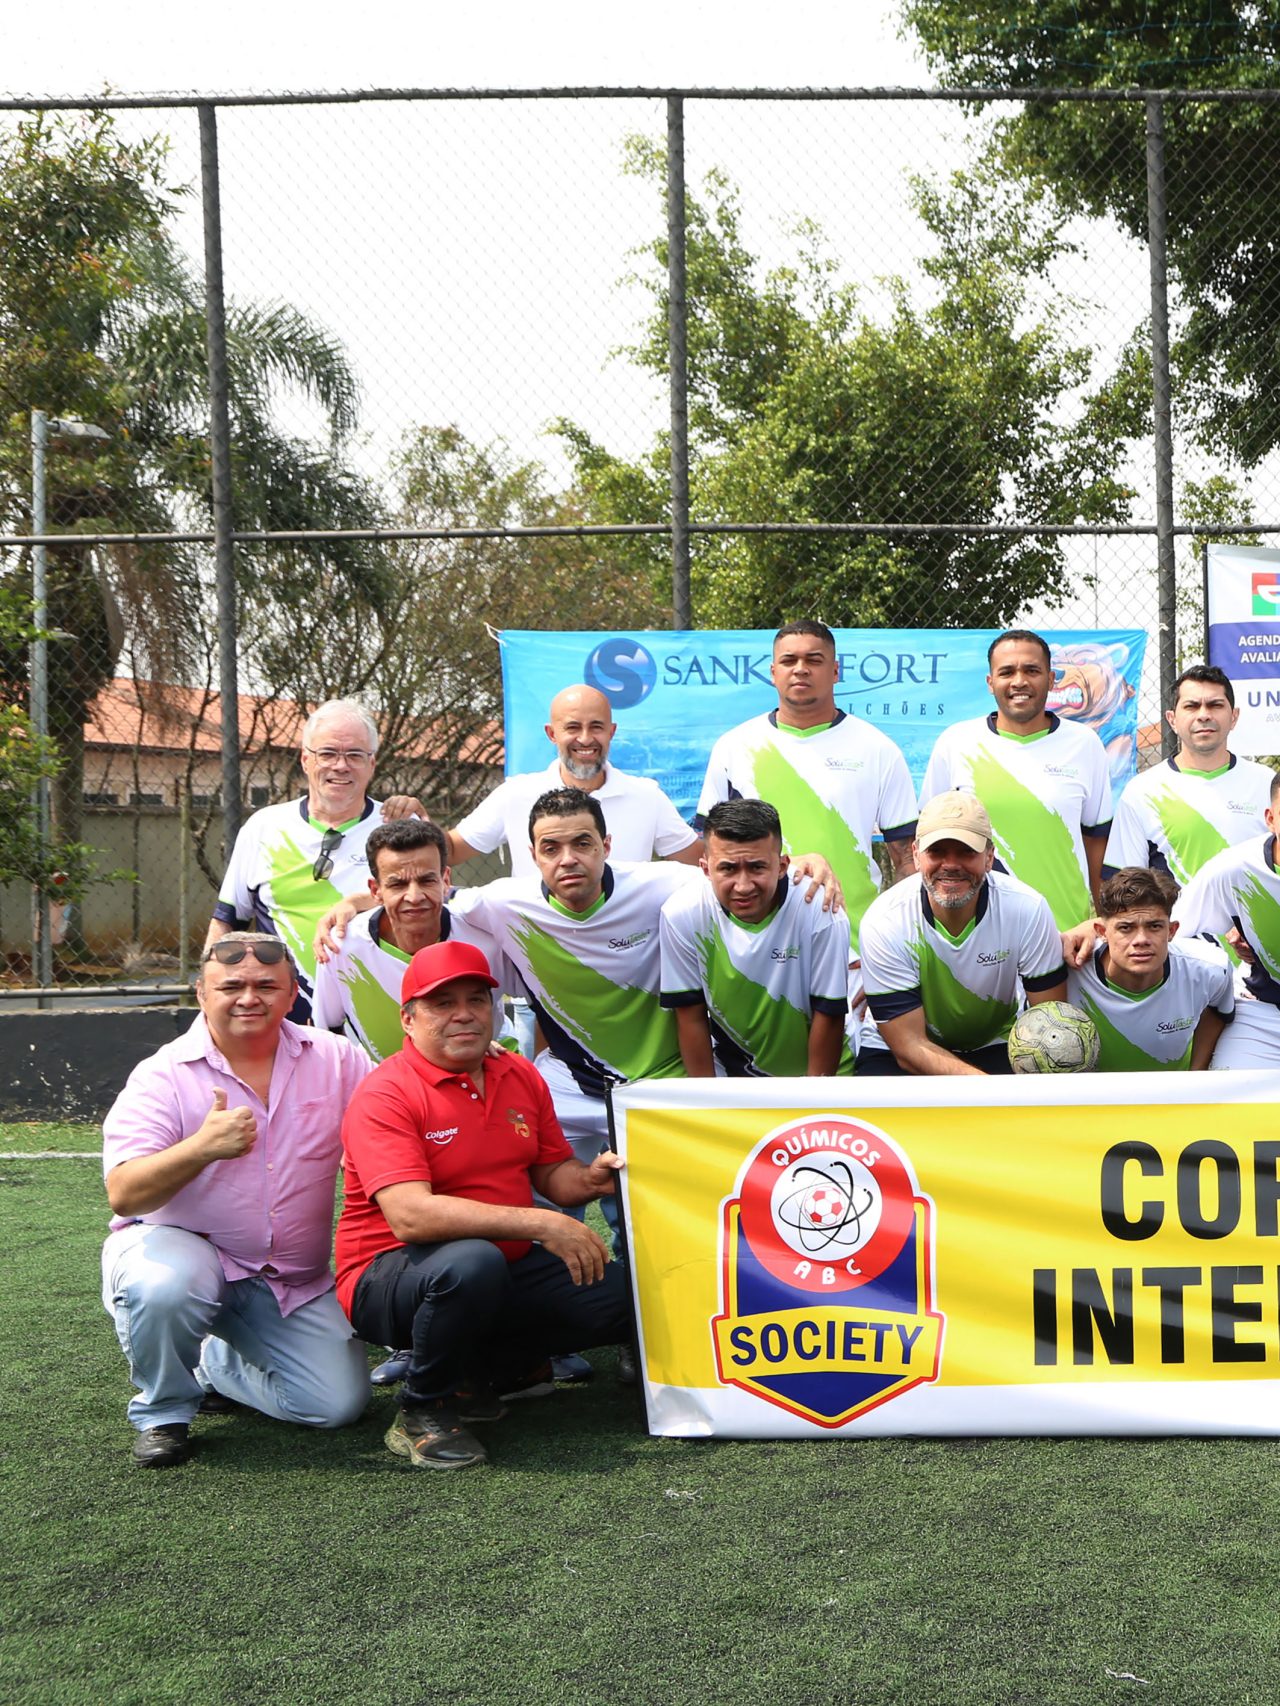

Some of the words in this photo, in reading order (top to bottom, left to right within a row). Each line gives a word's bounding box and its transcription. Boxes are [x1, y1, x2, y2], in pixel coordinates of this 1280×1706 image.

[425, 1127, 459, 1140] Colgate
[771, 1127, 881, 1168] QUÍMICOS
[730, 1320, 924, 1367] SOCIETY
